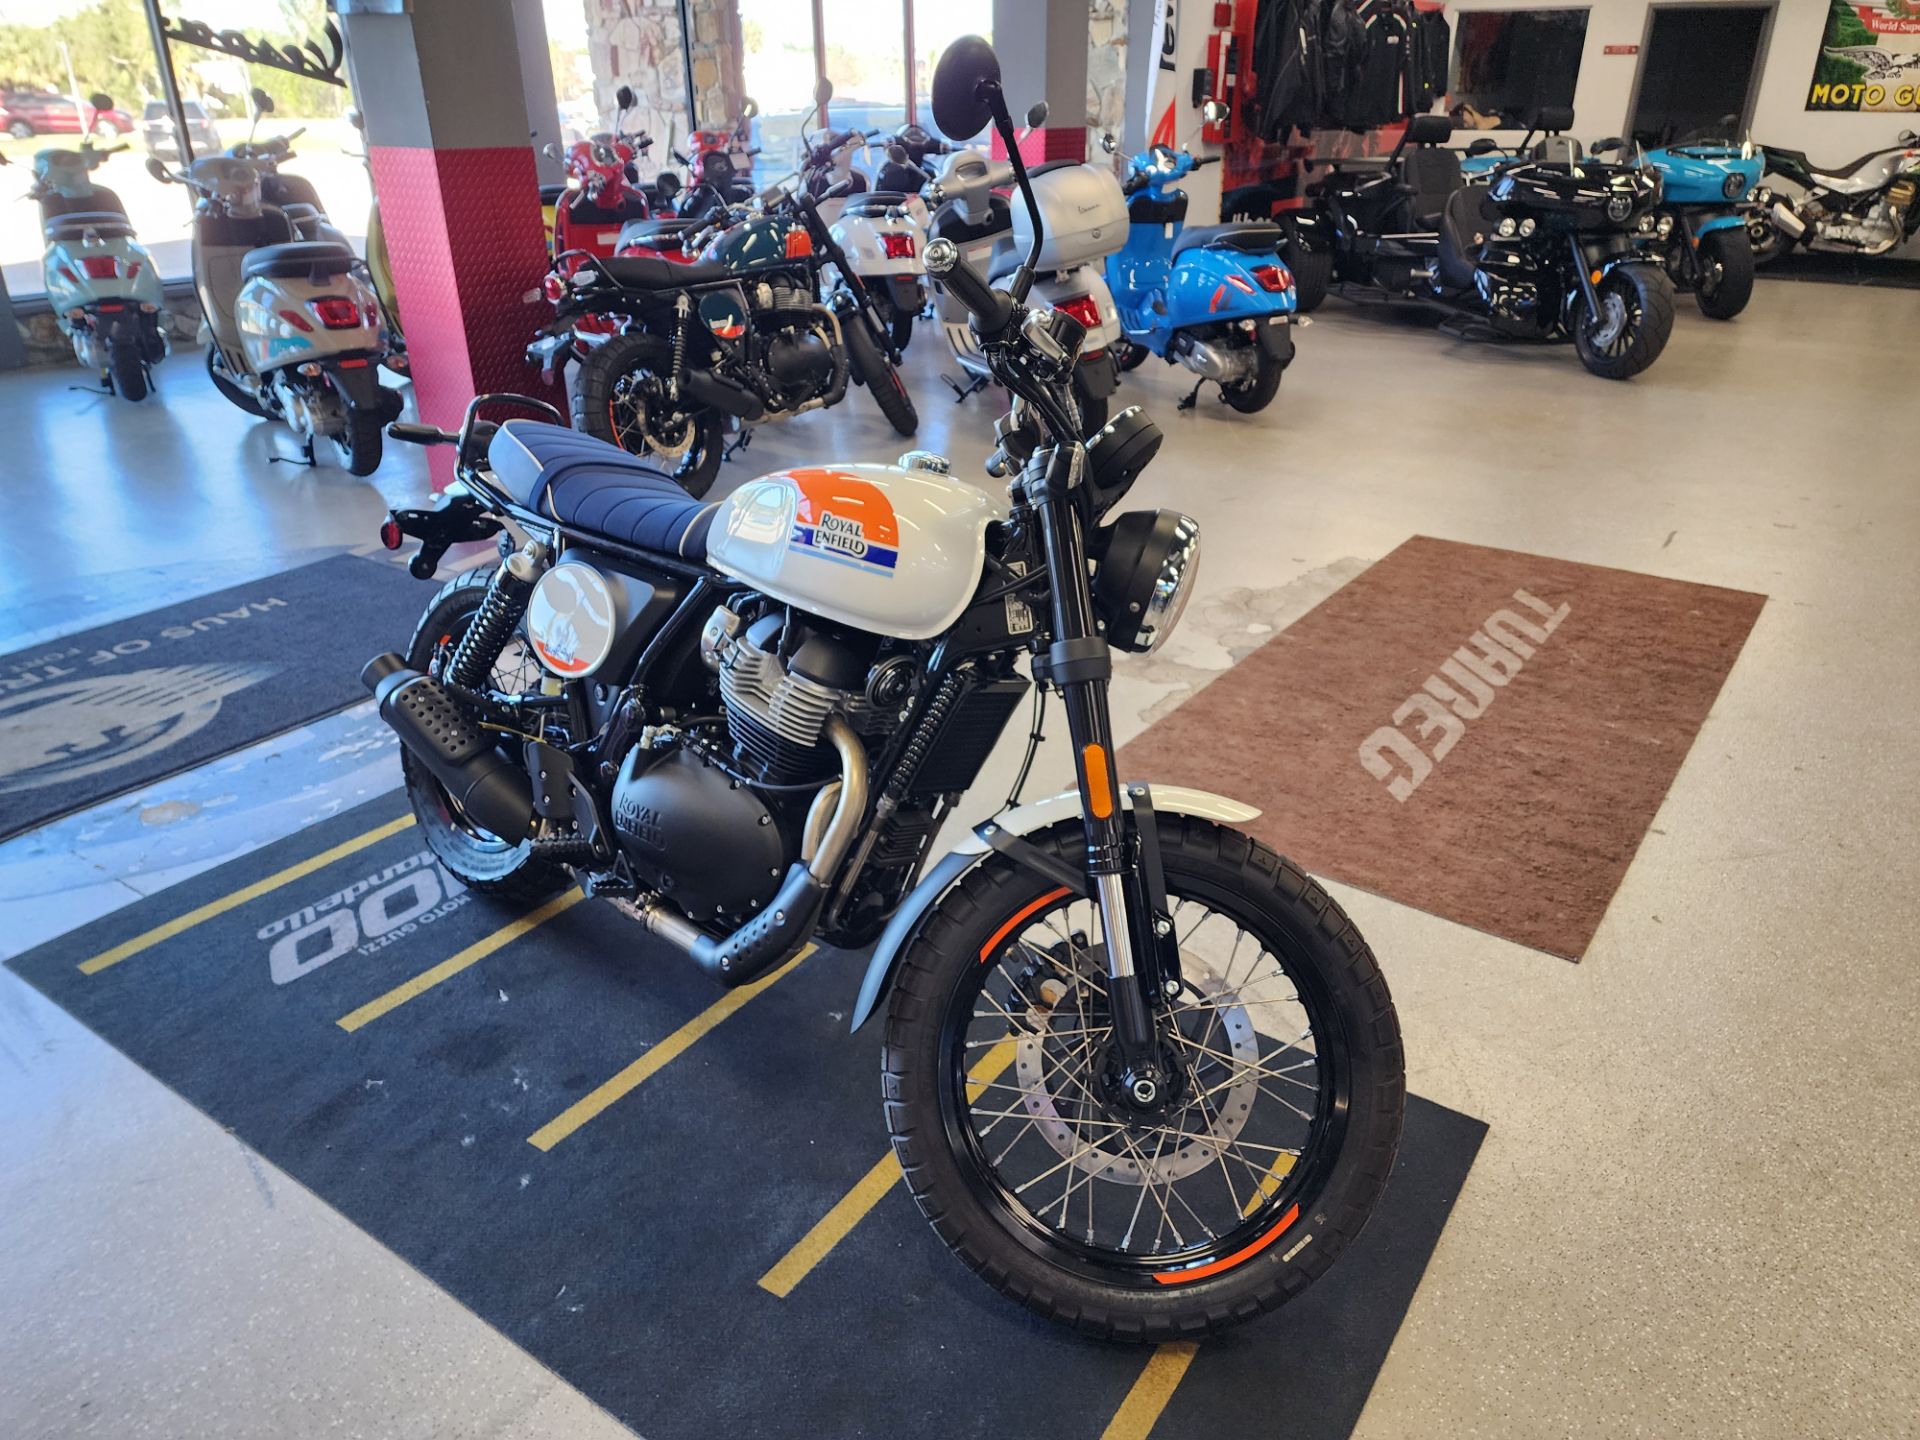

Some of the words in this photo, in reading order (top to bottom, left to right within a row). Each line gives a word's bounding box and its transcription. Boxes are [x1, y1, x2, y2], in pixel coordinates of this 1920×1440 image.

[1872, 19, 1898, 31] World
[1811, 83, 1886, 106] MOTO
[820, 512, 863, 538] ROYAL
[814, 530, 866, 555] ENFIELD
[161, 597, 288, 640] HAUS
[88, 639, 152, 665] OF
[0, 665, 77, 694] TR
[1358, 588, 1572, 804] TUAREG
[619, 791, 662, 827] ROYAL
[419, 894, 472, 925] MOTO
[357, 921, 419, 957] GUZZI
